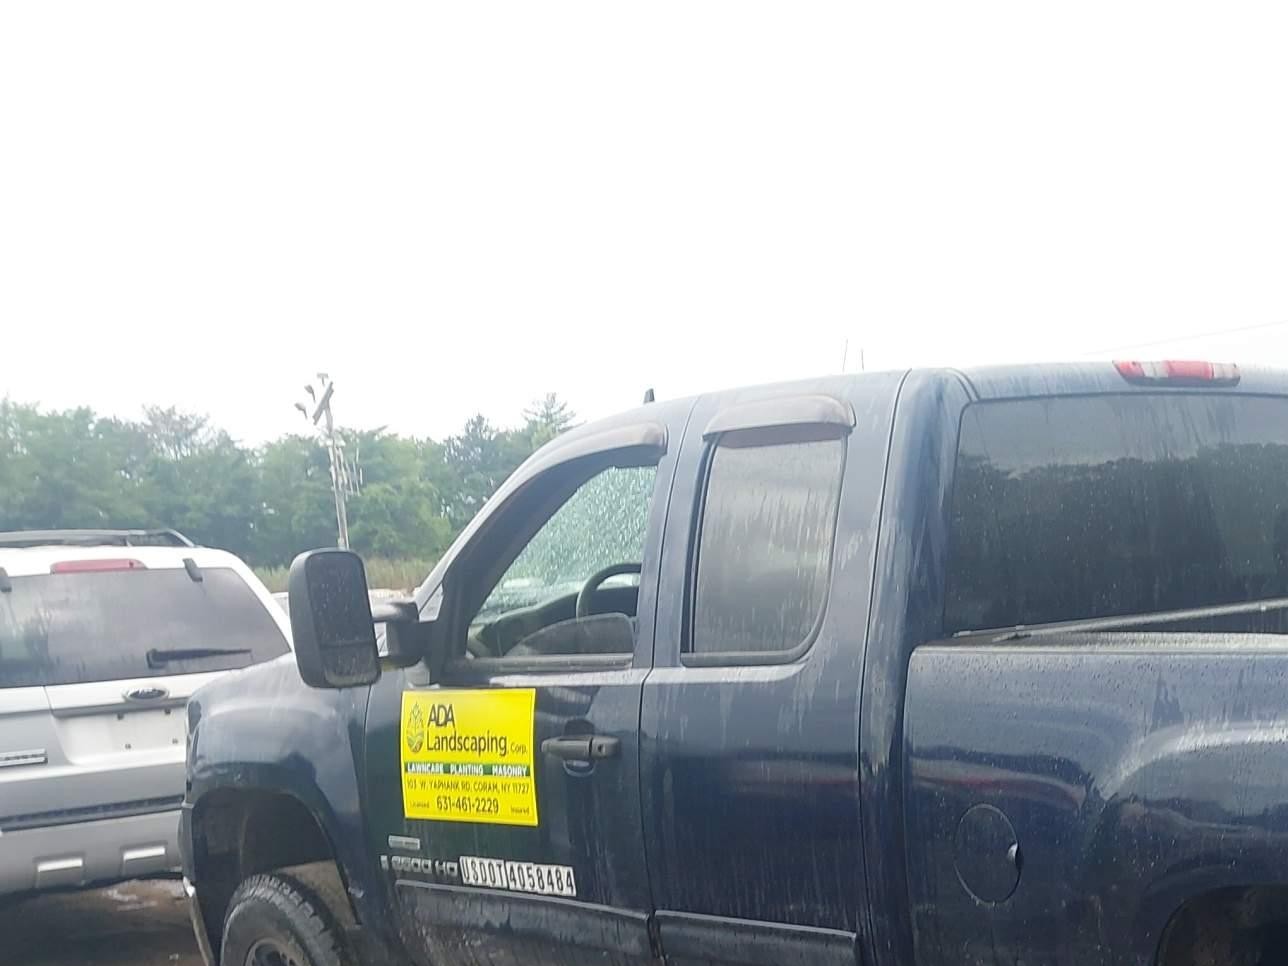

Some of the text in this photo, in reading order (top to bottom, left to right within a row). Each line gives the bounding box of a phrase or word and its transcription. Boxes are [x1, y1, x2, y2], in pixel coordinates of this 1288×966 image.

[427, 703, 456, 728] ADA
[510, 741, 528, 754] Corp.
[407, 762, 528, 777] LAWNCARE PLANTING MASONRY
[430, 781, 460, 792] YAPHANK
[501, 785, 511, 794] NY
[512, 785, 530, 795] 11727
[437, 795, 499, 814] 631-461-2229
